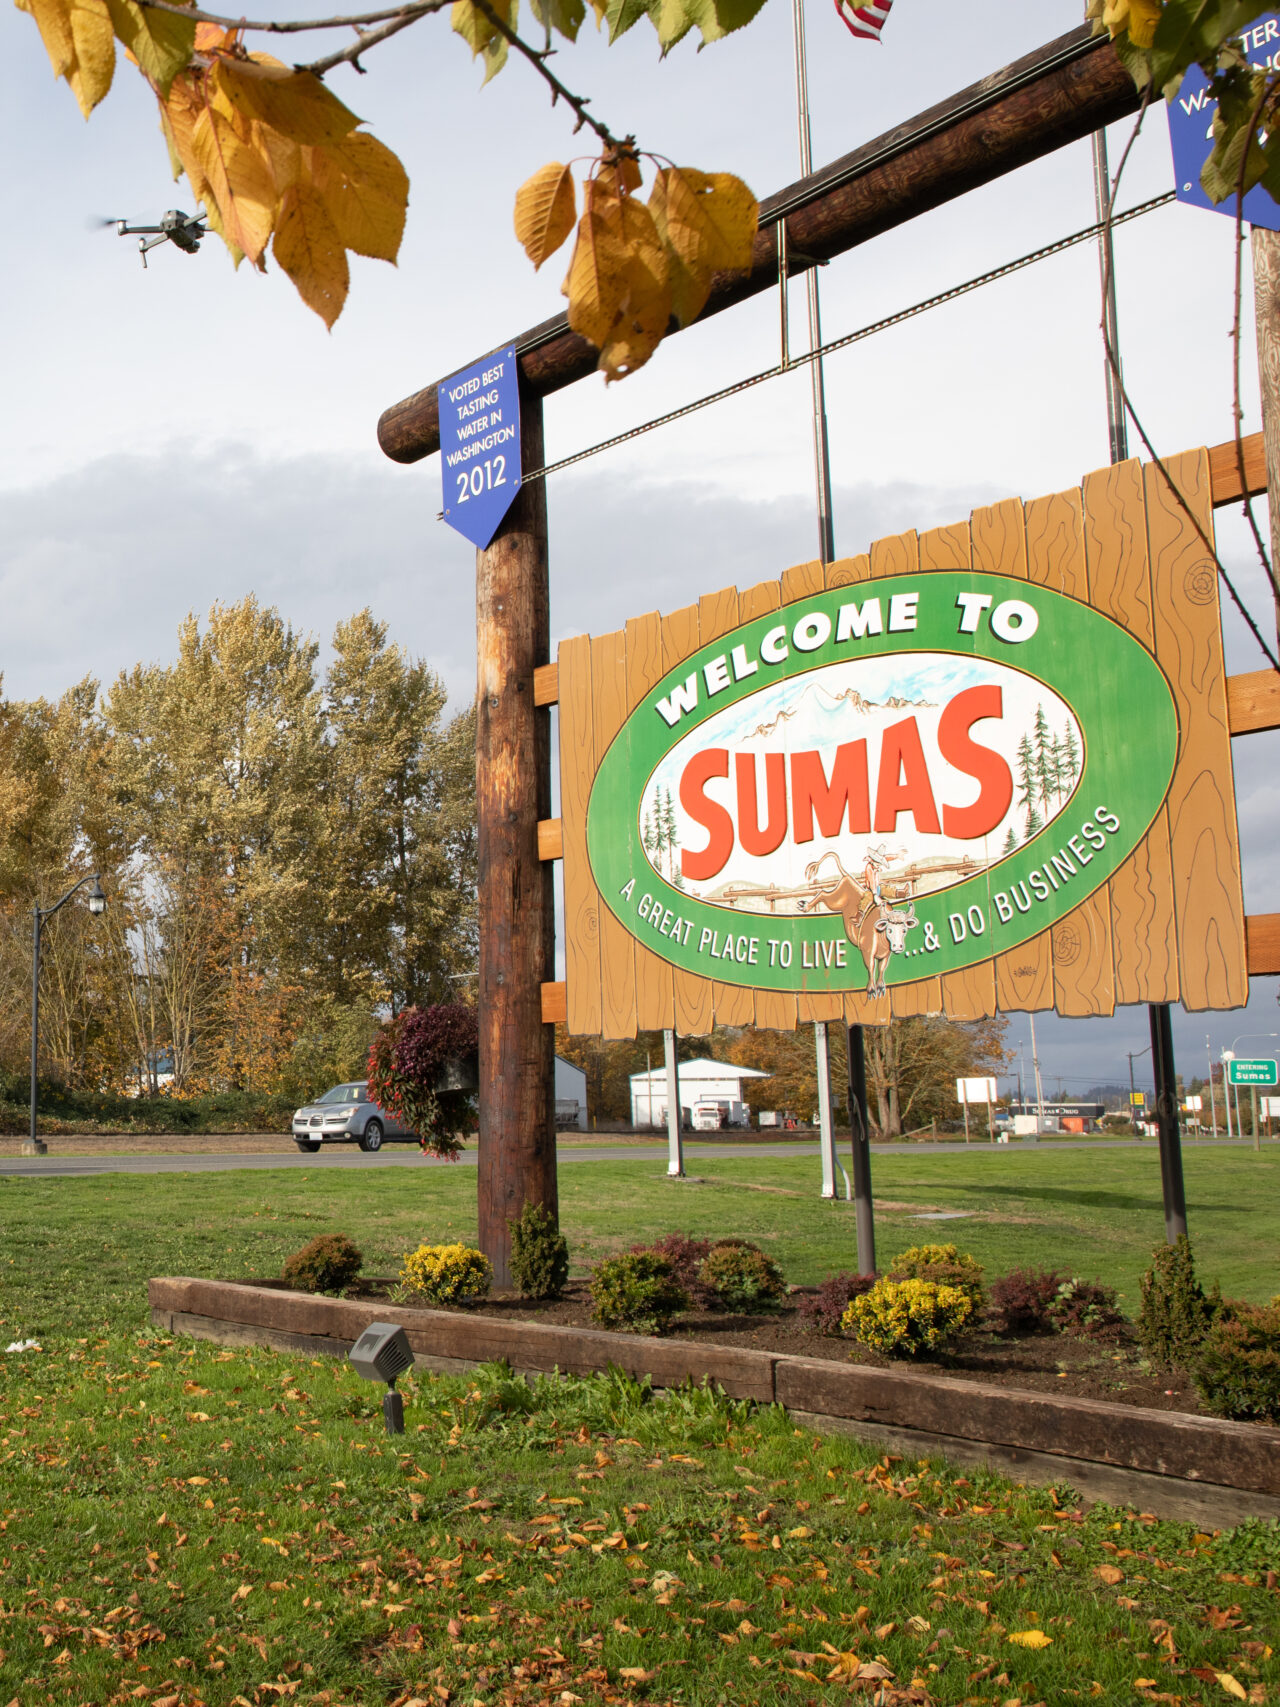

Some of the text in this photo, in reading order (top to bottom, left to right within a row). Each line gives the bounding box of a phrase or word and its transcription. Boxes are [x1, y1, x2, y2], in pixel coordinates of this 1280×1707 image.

[448, 363, 505, 403] VOTED BEST
[456, 389, 499, 420] TASTING
[446, 424, 515, 468] WASHINGTON
[456, 408, 502, 441] WATER IN
[456, 455, 507, 504] 2012
[654, 592, 1039, 728] WELCOME TO
[679, 684, 1013, 881] SUMAS
[619, 878, 636, 902] A
[637, 893, 695, 946] GREAT
[697, 928, 759, 964] PLACE
[768, 939, 793, 968] TO
[800, 939, 847, 969] LIVE
[948, 905, 985, 943] DO
[993, 806, 1120, 925] BUSINESS
[1235, 1072, 1271, 1080] Sumas
